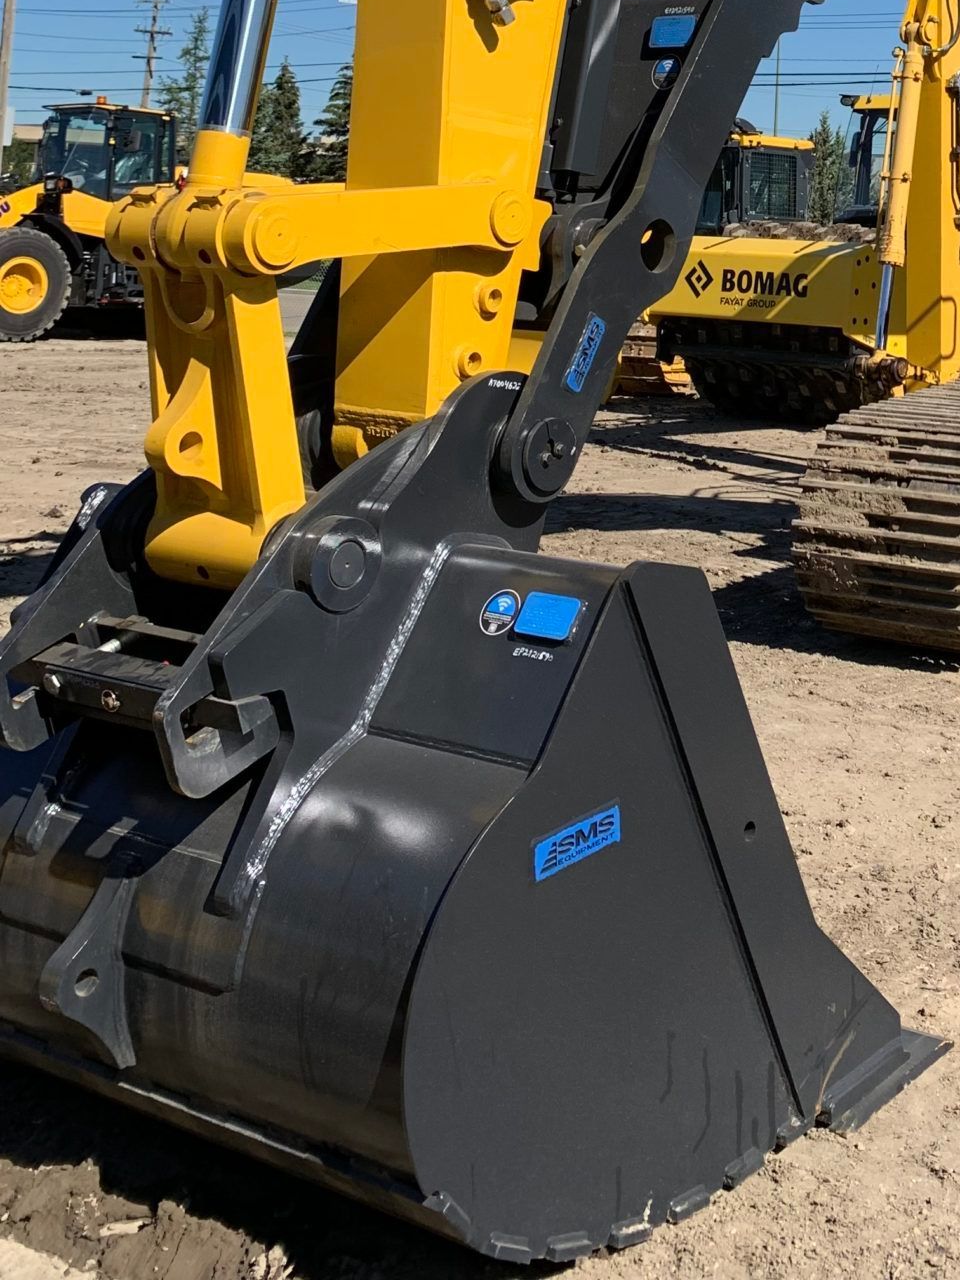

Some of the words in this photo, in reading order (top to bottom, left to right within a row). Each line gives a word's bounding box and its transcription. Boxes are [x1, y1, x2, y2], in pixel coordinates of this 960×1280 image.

[0, 200, 11, 218] U
[721, 268, 809, 298] BOMAG
[719, 297, 745, 307] FAYAT
[746, 298, 777, 309] GROUP
[576, 321, 600, 369] SMS
[557, 831, 616, 866] EQUIPMENT
